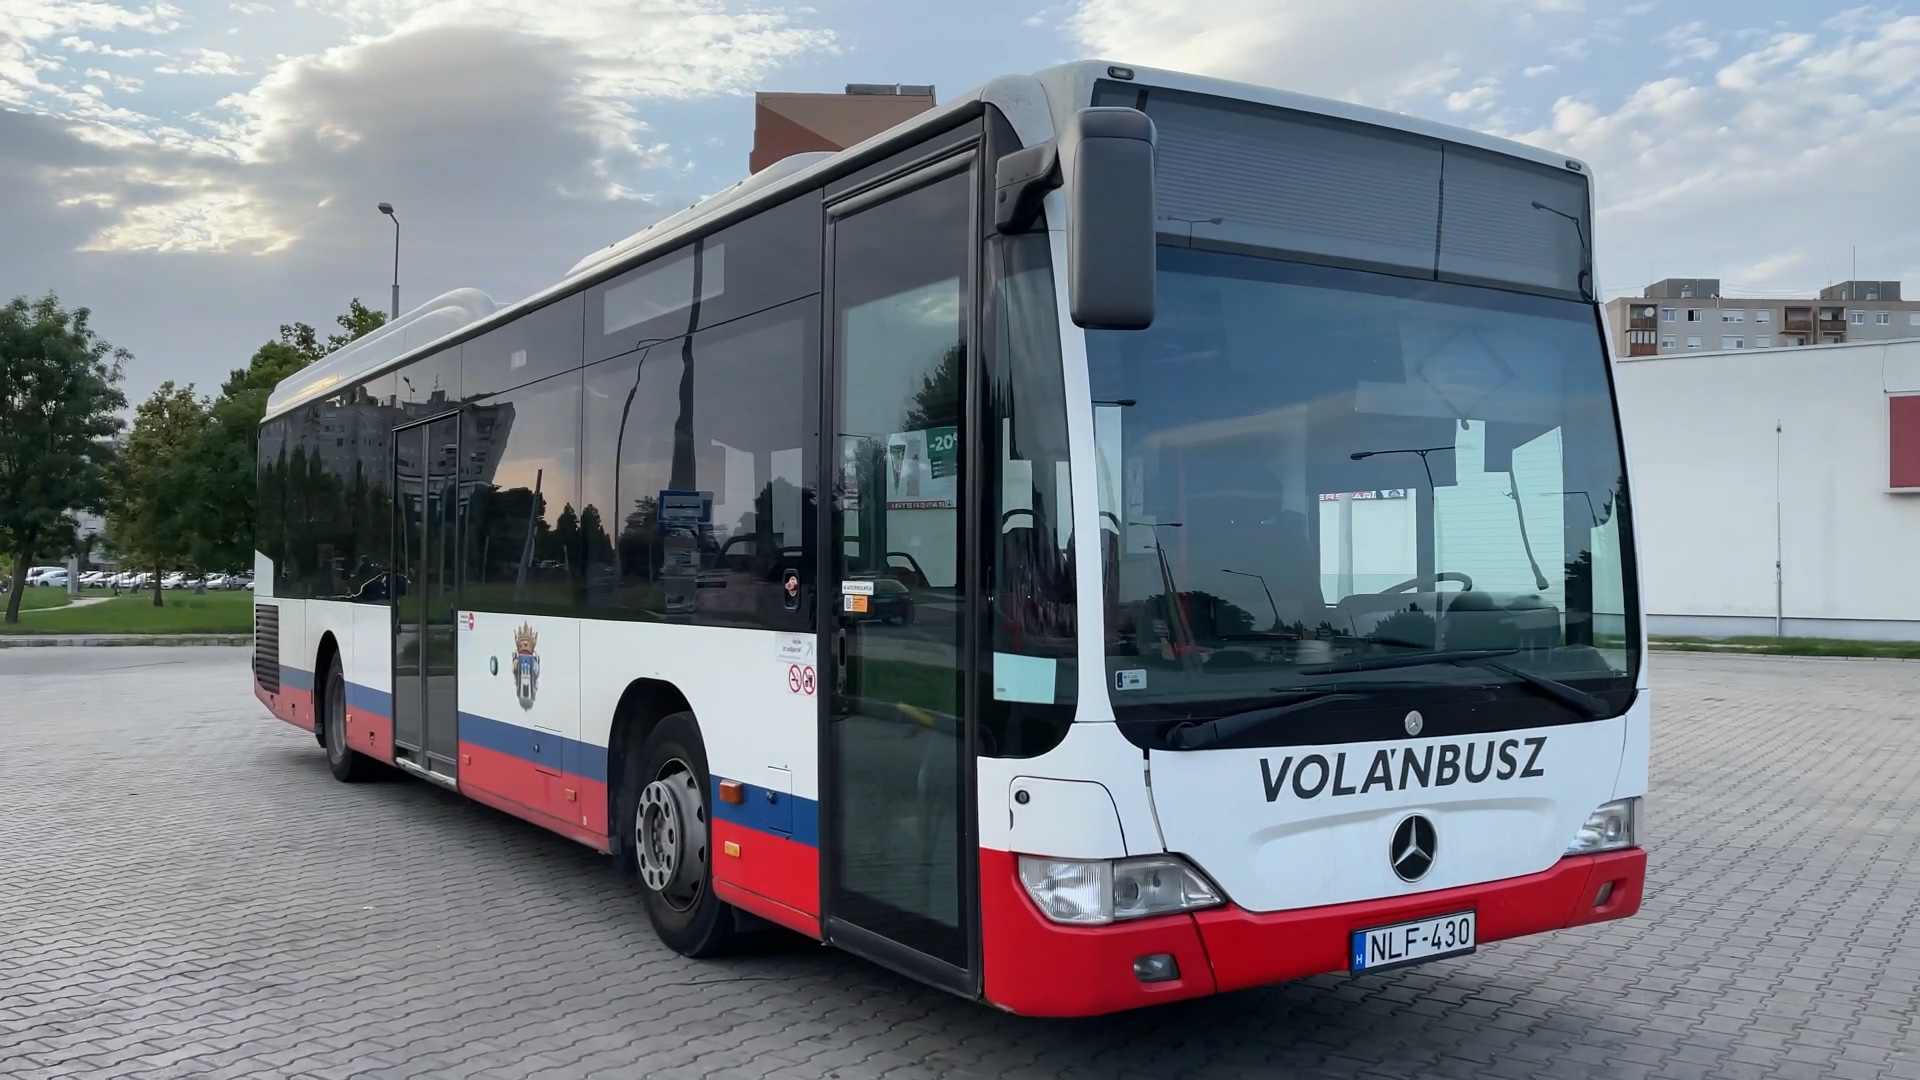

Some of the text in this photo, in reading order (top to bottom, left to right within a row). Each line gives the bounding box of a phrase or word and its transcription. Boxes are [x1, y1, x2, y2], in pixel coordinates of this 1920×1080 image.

[1259, 736, 1548, 802] VOLÁNBUSZ
[1355, 953, 1363, 965] H
[1371, 918, 1470, 963] NLF-430
